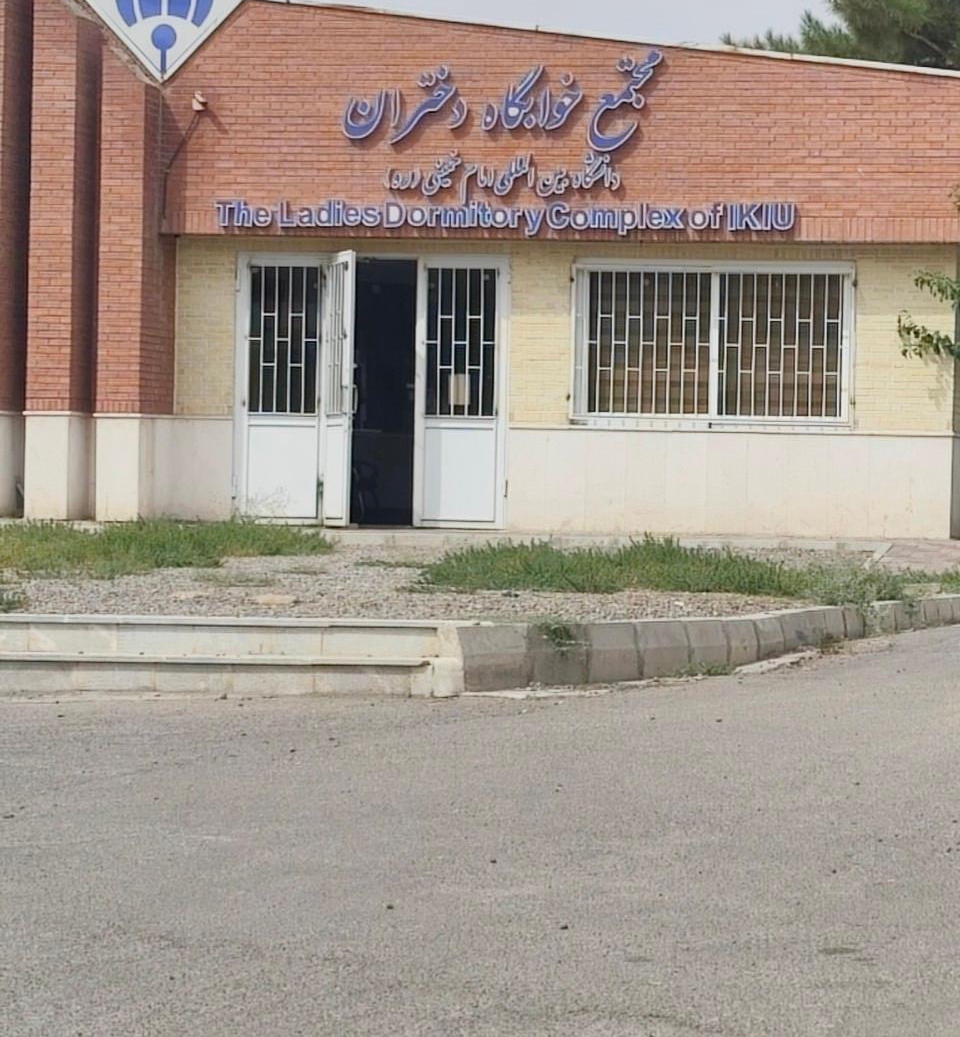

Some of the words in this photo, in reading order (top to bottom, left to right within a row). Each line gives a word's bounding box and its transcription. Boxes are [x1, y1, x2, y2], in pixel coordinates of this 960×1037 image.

[342, 65, 468, 146] دختران
[481, 64, 584, 132] خوابگاه
[587, 48, 664, 152] مجتمع
[459, 164, 494, 205] امام
[571, 151, 621, 192] دانشگاه
[215, 200, 272, 228] The
[276, 200, 382, 229] Ladies
[382, 200, 546, 237] Dormitory
[545, 202, 684, 236] Complex
[687, 203, 724, 231] of
[724, 202, 798, 232] IKIU
